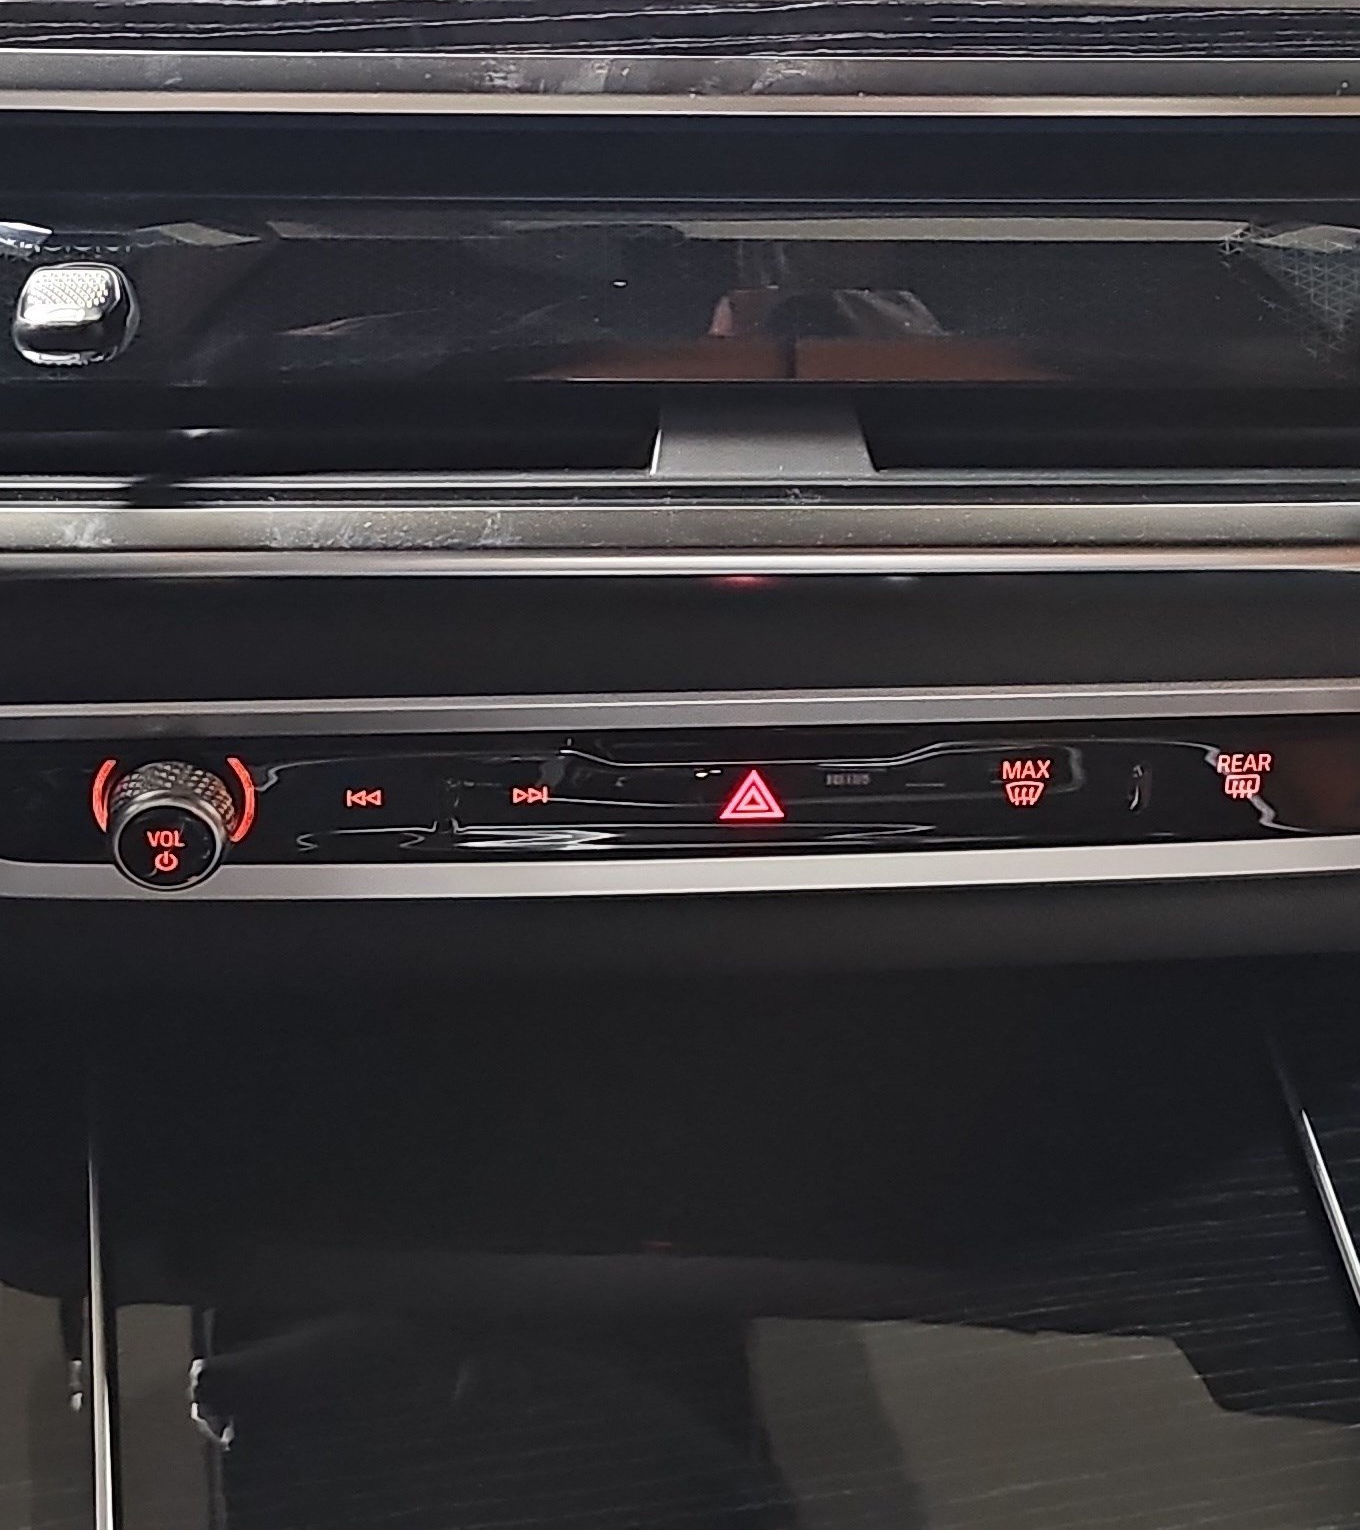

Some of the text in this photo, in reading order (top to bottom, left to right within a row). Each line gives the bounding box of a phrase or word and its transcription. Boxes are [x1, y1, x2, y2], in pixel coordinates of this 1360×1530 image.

[1002, 759, 1051, 779] MAX
[1216, 752, 1271, 773] REAR
[146, 829, 186, 848] VOL
